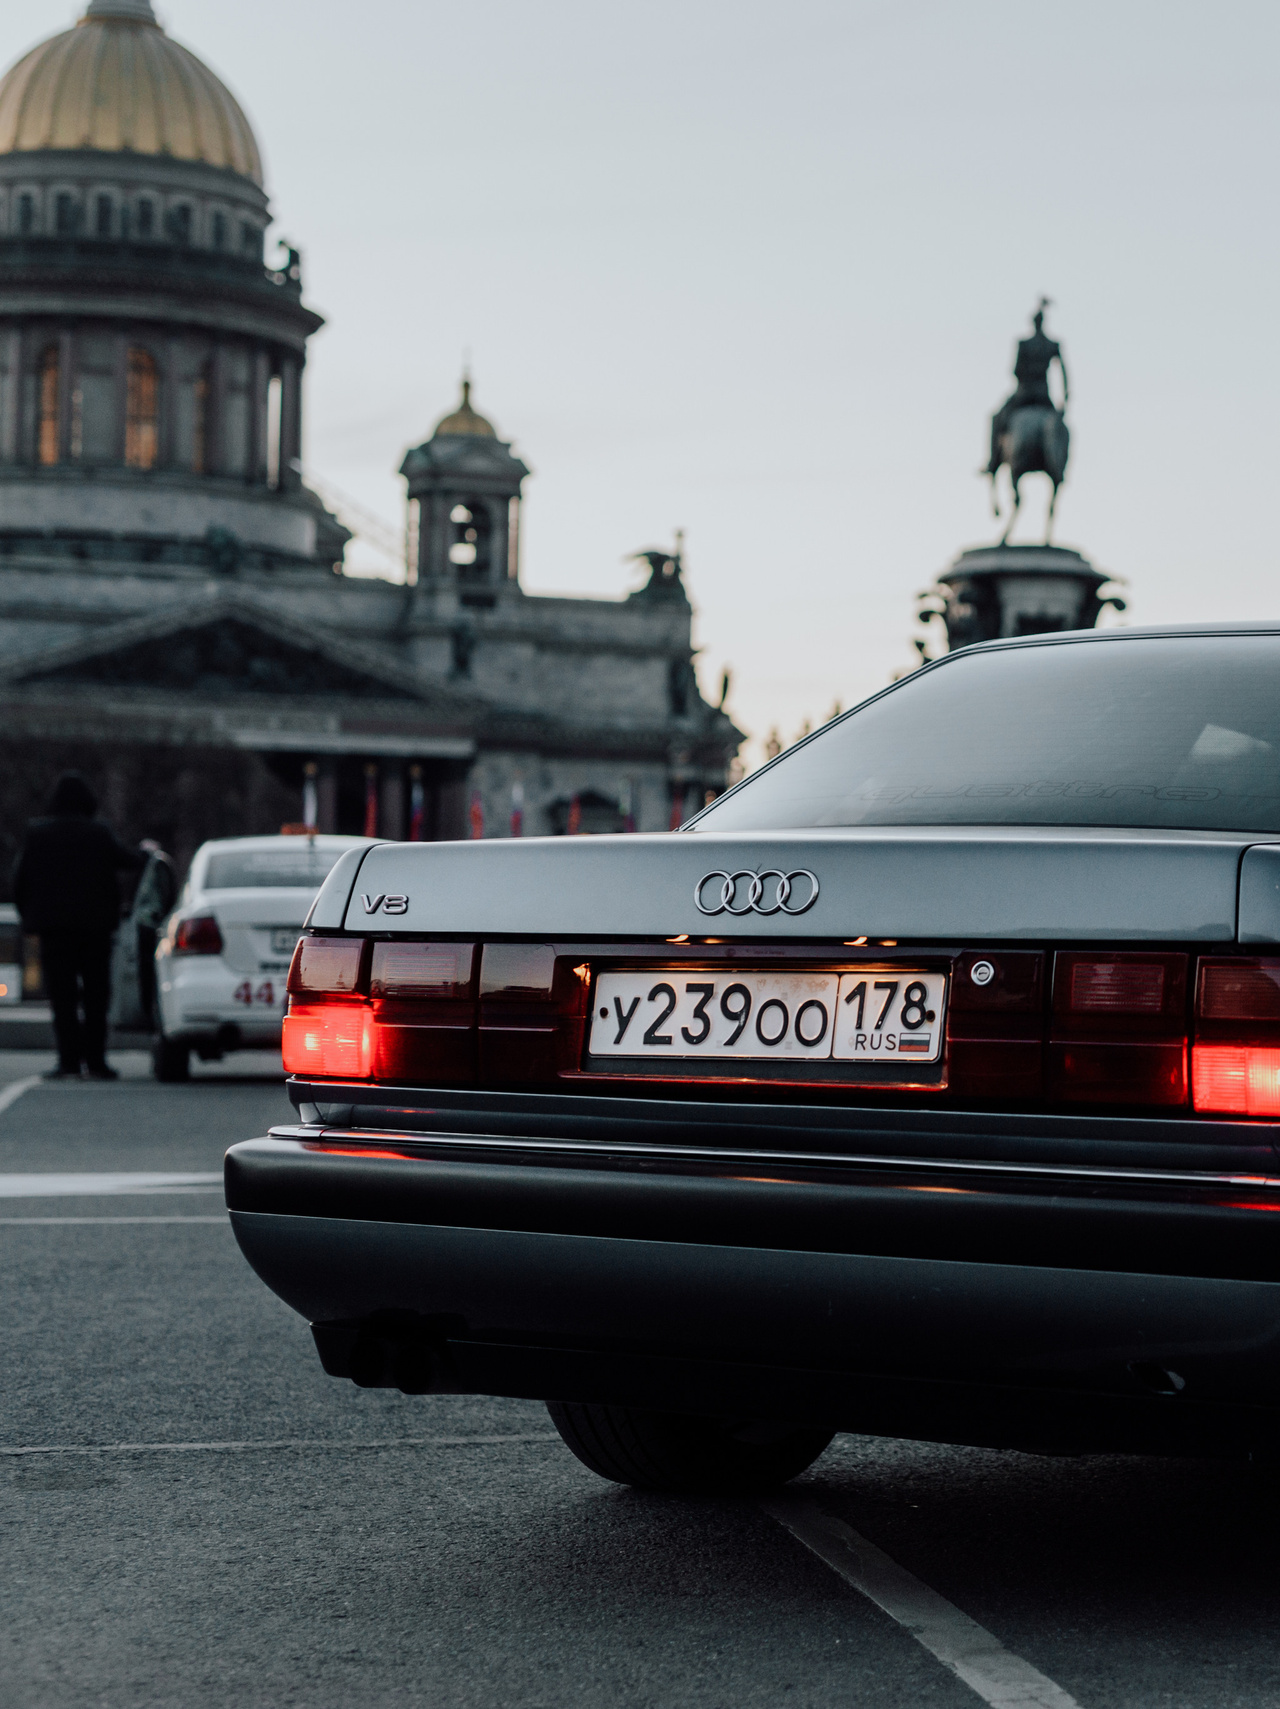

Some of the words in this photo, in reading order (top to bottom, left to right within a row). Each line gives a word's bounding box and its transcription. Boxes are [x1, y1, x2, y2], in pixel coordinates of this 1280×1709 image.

[860, 779, 1222, 803] quattro
[360, 893, 410, 915] V8
[844, 981, 926, 1030] 178
[854, 1033, 897, 1052] RUS
